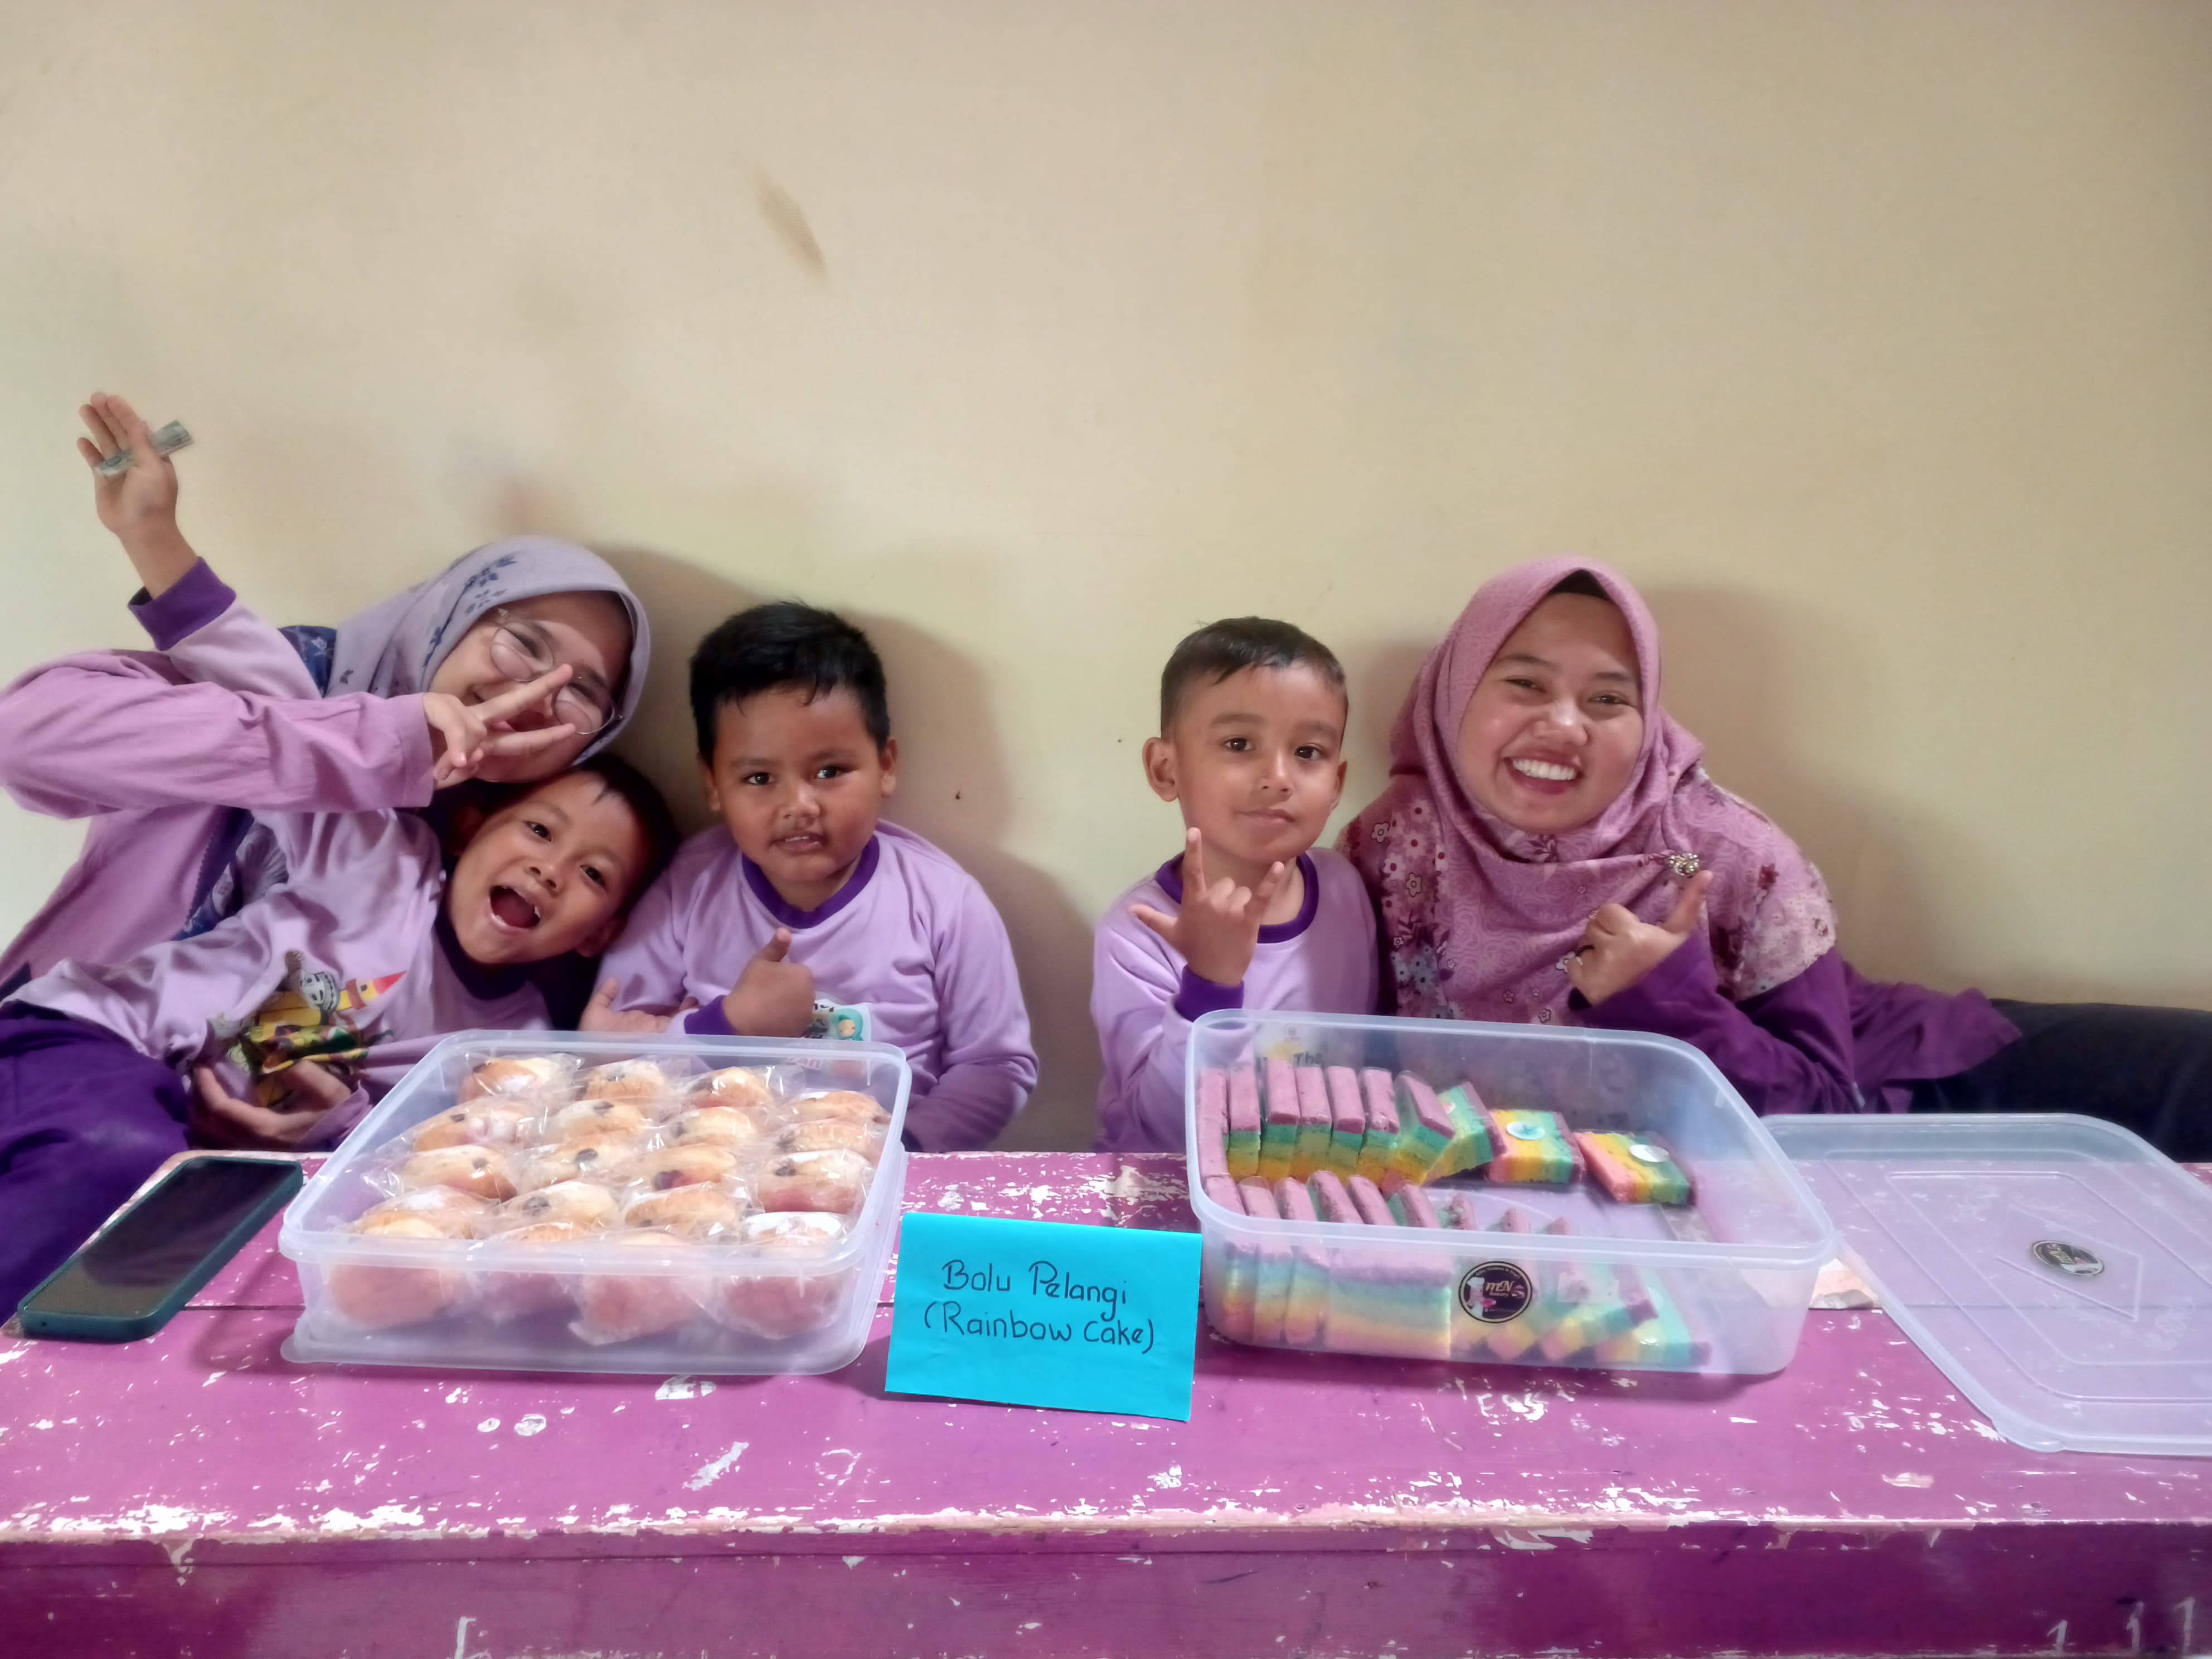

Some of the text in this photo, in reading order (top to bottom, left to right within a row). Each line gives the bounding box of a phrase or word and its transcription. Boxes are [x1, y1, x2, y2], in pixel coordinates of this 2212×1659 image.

[942, 1259, 1127, 1322] Bolu Pelangi
[924, 1301, 1154, 1355] (Rainbow Cake)
